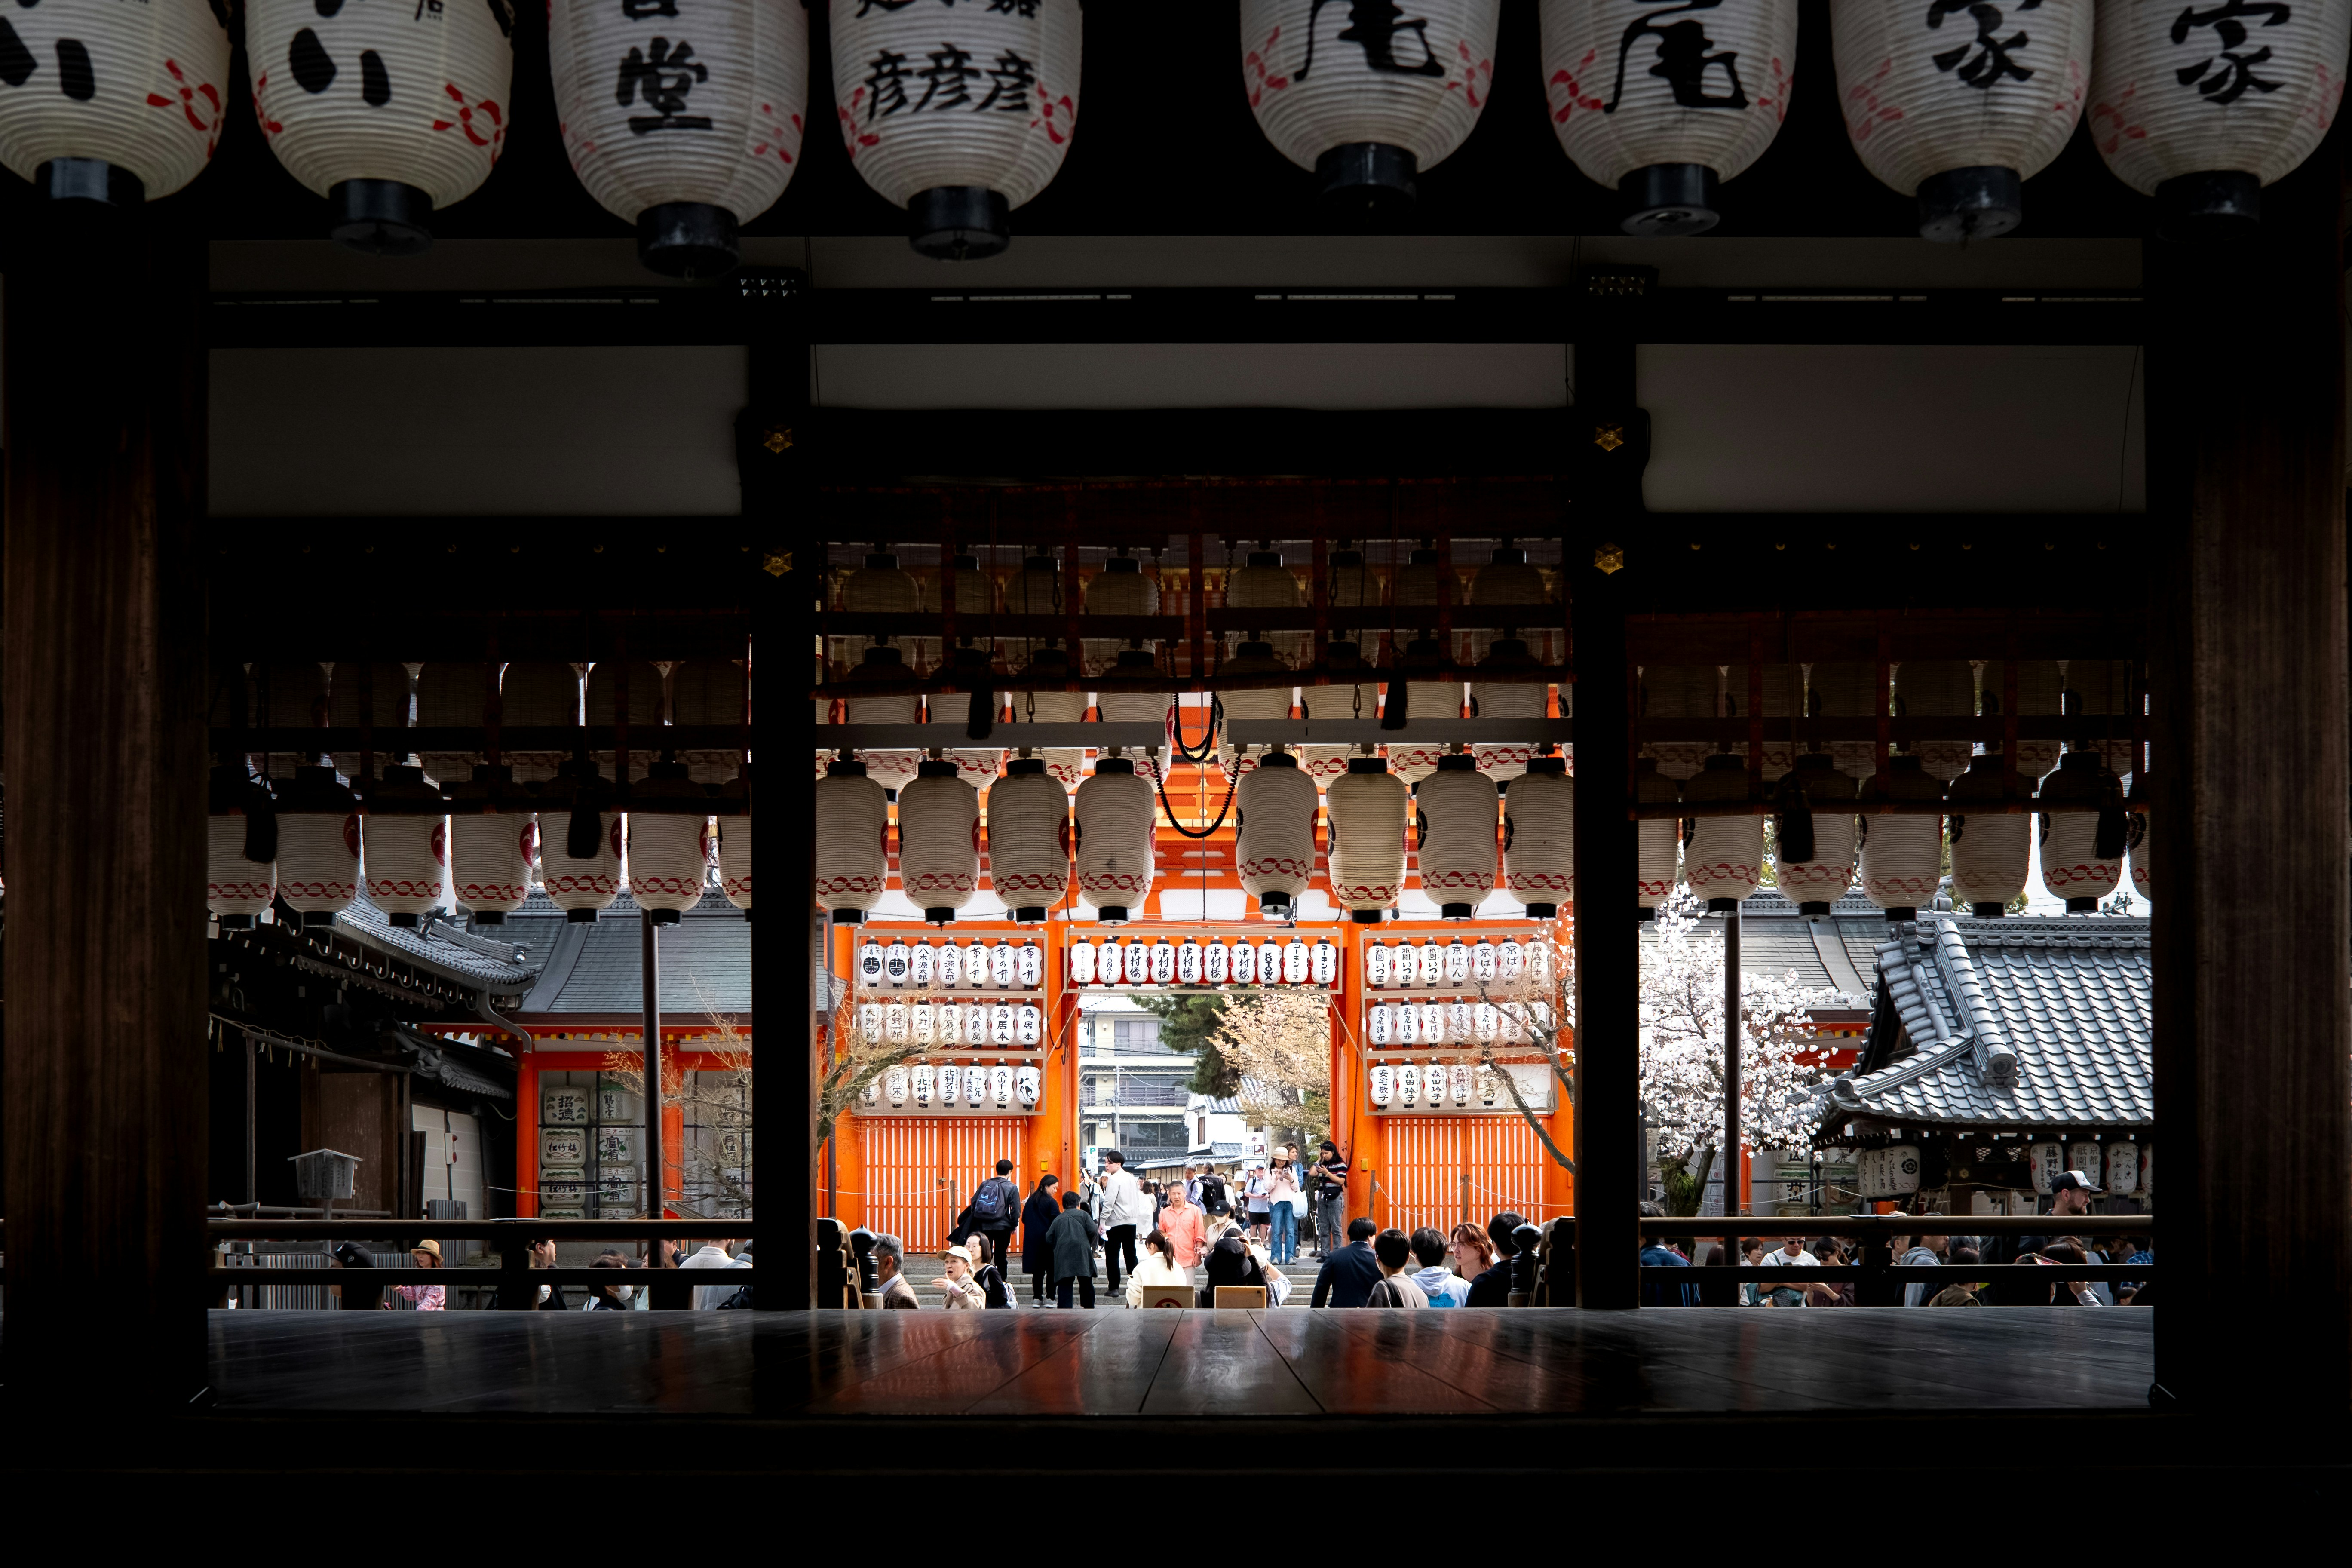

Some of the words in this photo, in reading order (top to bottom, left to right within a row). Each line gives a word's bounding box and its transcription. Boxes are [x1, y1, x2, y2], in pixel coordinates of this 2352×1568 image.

[616, 0, 713, 136] 堂
[918, 948, 929, 981] 八木源太郎
[944, 947, 956, 981] 八木源太郎
[1130, 946, 1141, 978] 中村楼
[1158, 947, 1169, 979] 中村楼
[1183, 946, 1193, 979] 中村楼
[1210, 946, 1221, 979] 中村楼
[1238, 948, 1250, 979] 中村楼
[1264, 952, 1273, 980] KOTOWA
[1452, 945, 1463, 977] 京ばん
[1506, 945, 1518, 976] 京ばん
[997, 1009, 1009, 1041] 鳥居本
[1024, 1009, 1034, 1040] 鳥居本
[917, 1079, 929, 1102] 北村健
[944, 1069, 955, 1100] 北村クリニック
[1379, 1069, 1389, 1102] 安宅敬子
[1404, 1070, 1416, 1102] 森田玲子
[1431, 1070, 1442, 1101] 森田玲子
[548, 1142, 577, 1152] 松竹梅
[605, 1135, 619, 1161] 富翁
[2090, 1145, 2098, 1165] 京都
[607, 1175, 621, 1202] 富翁
